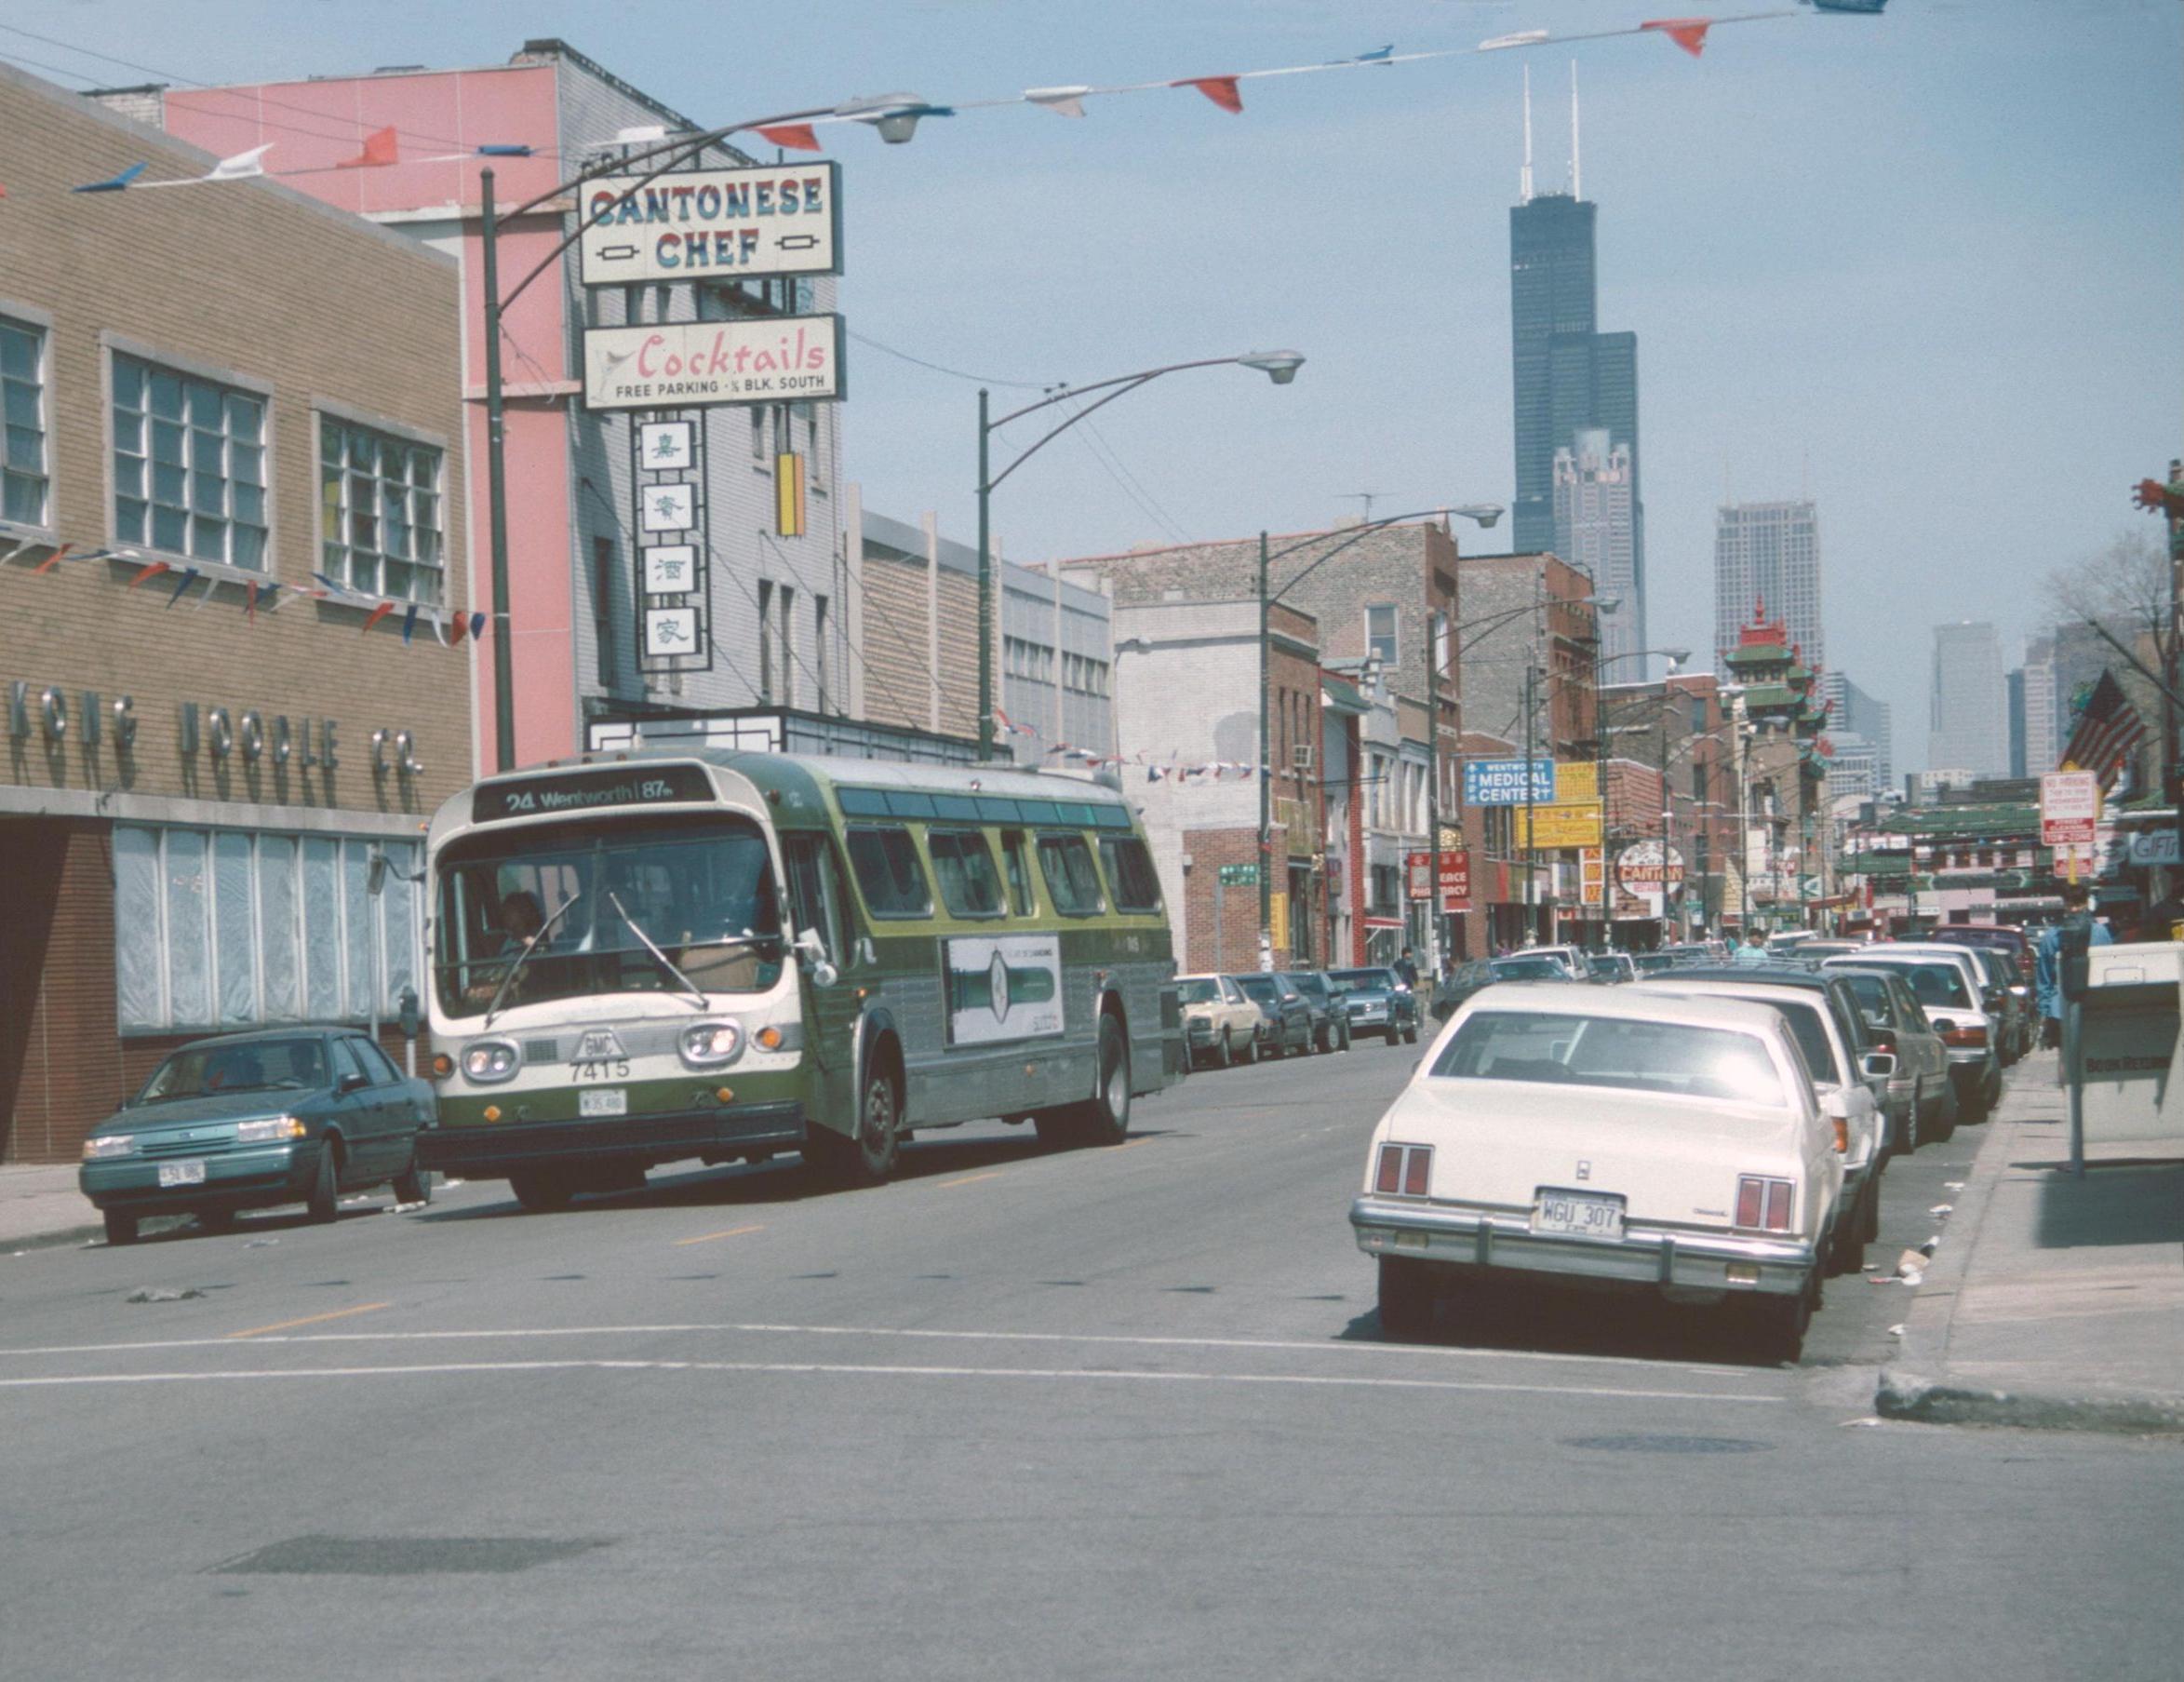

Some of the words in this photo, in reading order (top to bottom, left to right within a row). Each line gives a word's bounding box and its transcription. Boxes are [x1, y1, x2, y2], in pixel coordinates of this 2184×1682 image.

[590, 177, 823, 226] CANTONESE
[656, 228, 759, 268] CHEF
[637, 328, 825, 378] Cocktails
[616, 383, 651, 397] FREE
[658, 381, 718, 396] PARKING
[745, 377, 773, 391] BLK.
[780, 375, 824, 389] SOUTH
[7, 680, 137, 750] KONG
[179, 702, 339, 768] NOODLE
[1480, 773, 1550, 787] MEDICAL
[541, 786, 629, 807] Wentworth
[585, 1034, 613, 1056] GMC
[569, 1057, 630, 1082] 7415
[1544, 1201, 1575, 1223] WGU
[1585, 1206, 1616, 1228] 307
